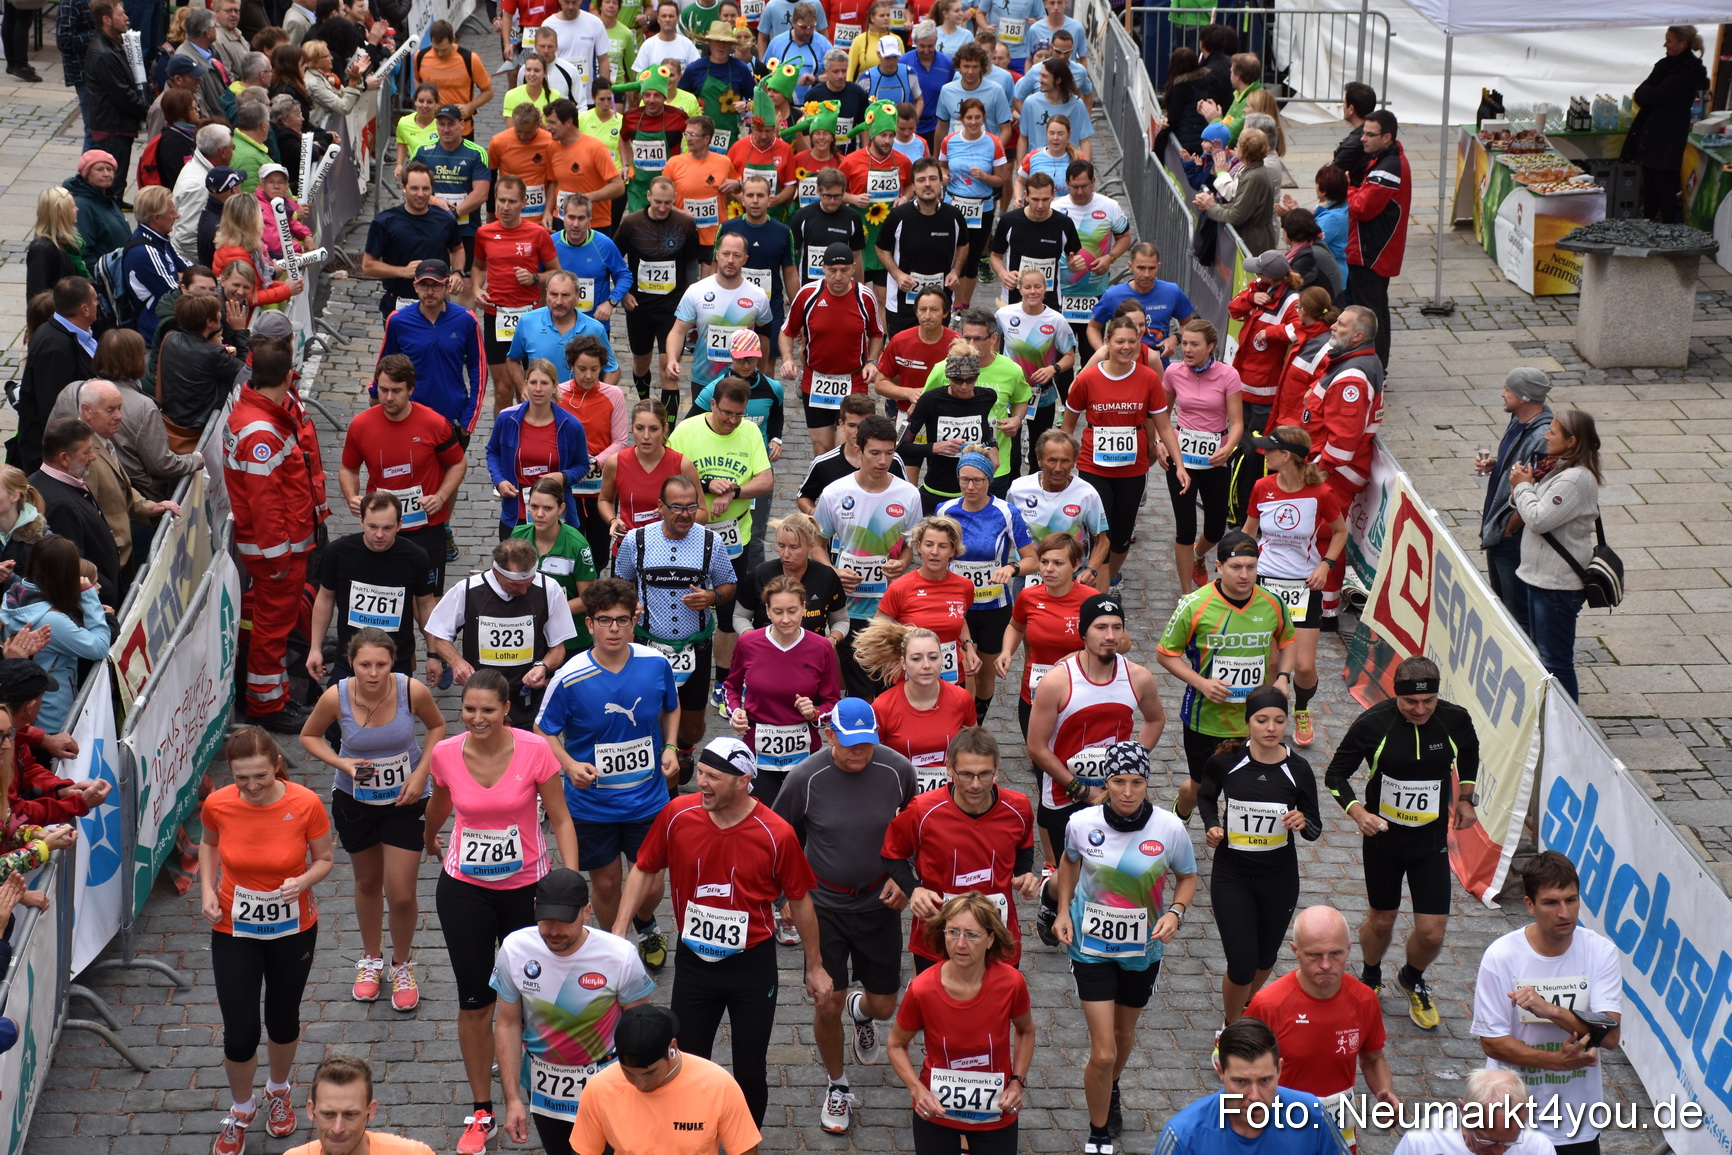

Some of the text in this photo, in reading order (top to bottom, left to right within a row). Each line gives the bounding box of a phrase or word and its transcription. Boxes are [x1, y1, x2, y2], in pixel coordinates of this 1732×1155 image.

[1004, 25, 1021, 35] 183
[636, 148, 664, 160] 2140
[871, 178, 898, 190] 2423
[687, 205, 715, 217] 2136
[279, 220, 292, 242] BMW
[646, 270, 669, 282] 124
[1066, 298, 1096, 310] 2488
[712, 335, 726, 347] 21
[816, 380, 848, 395] 2208
[1093, 403, 1137, 411] NEUMARKT
[942, 427, 979, 441] 2249
[1098, 437, 1134, 452] 2160
[1181, 439, 1216, 456] 2169
[694, 457, 748, 476] FINISHER
[400, 498, 421, 513] 75
[722, 530, 738, 545] 29
[371, 588, 396, 596] Neumarkt
[1281, 591, 1300, 605] 93
[355, 594, 397, 614] 2761
[804, 609, 820, 618] Team
[359, 615, 390, 625] Christian
[490, 630, 524, 648] 323
[1207, 631, 1272, 649] BOCK
[495, 652, 518, 660] Lothar
[1218, 667, 1261, 687] 2709
[617, 743, 643, 753] Neumarkt
[761, 735, 806, 755] 2305
[372, 759, 402, 768] Neumarkt
[602, 750, 650, 774] 3039
[918, 778, 948, 794] 546
[1382, 779, 1401, 790] PARTL
[373, 790, 395, 799] Sarah
[1393, 792, 1428, 811] 176
[1397, 812, 1418, 821] Klaus
[1240, 814, 1277, 834] 177
[1248, 837, 1268, 845] Lena
[466, 839, 517, 863] 2784
[1142, 843, 1161, 852] Hervis
[473, 865, 510, 875] Christina
[965, 873, 982, 883] DEHN
[235, 891, 255, 901] PARTL
[238, 901, 292, 922] 2491
[706, 912, 737, 922] Neumarkt
[1086, 907, 1105, 916] PARTL
[690, 916, 740, 946] 2043
[1089, 918, 1139, 941] 2801
[699, 945, 726, 957] Robert
[1105, 943, 1120, 952] Eva
[523, 980, 541, 988] PARTL
[582, 976, 604, 986] Hervis
[532, 1059, 584, 1074] PARTL Neumarkt
[536, 1070, 584, 1097] 2721
[958, 1076, 992, 1085] Neumarkt
[939, 1085, 998, 1111] 2547
[673, 1121, 704, 1131] THULE
